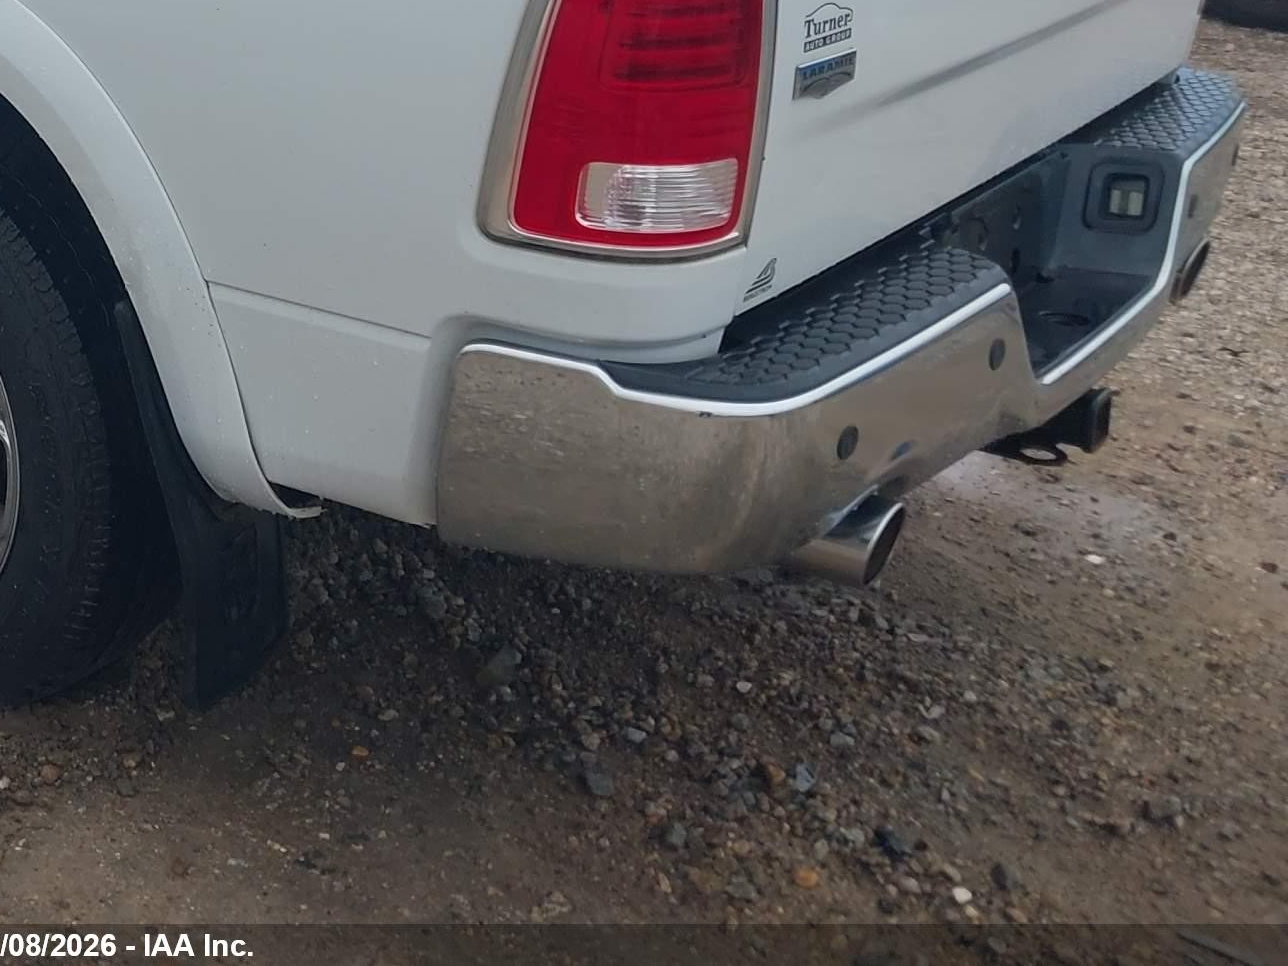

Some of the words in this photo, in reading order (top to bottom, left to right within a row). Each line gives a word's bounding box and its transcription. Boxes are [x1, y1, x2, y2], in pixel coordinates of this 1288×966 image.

[804, 13, 850, 39] Turner
[805, 36, 824, 51] AUTO
[825, 29, 851, 45] GROUP
[801, 56, 855, 81] LARAMIE
